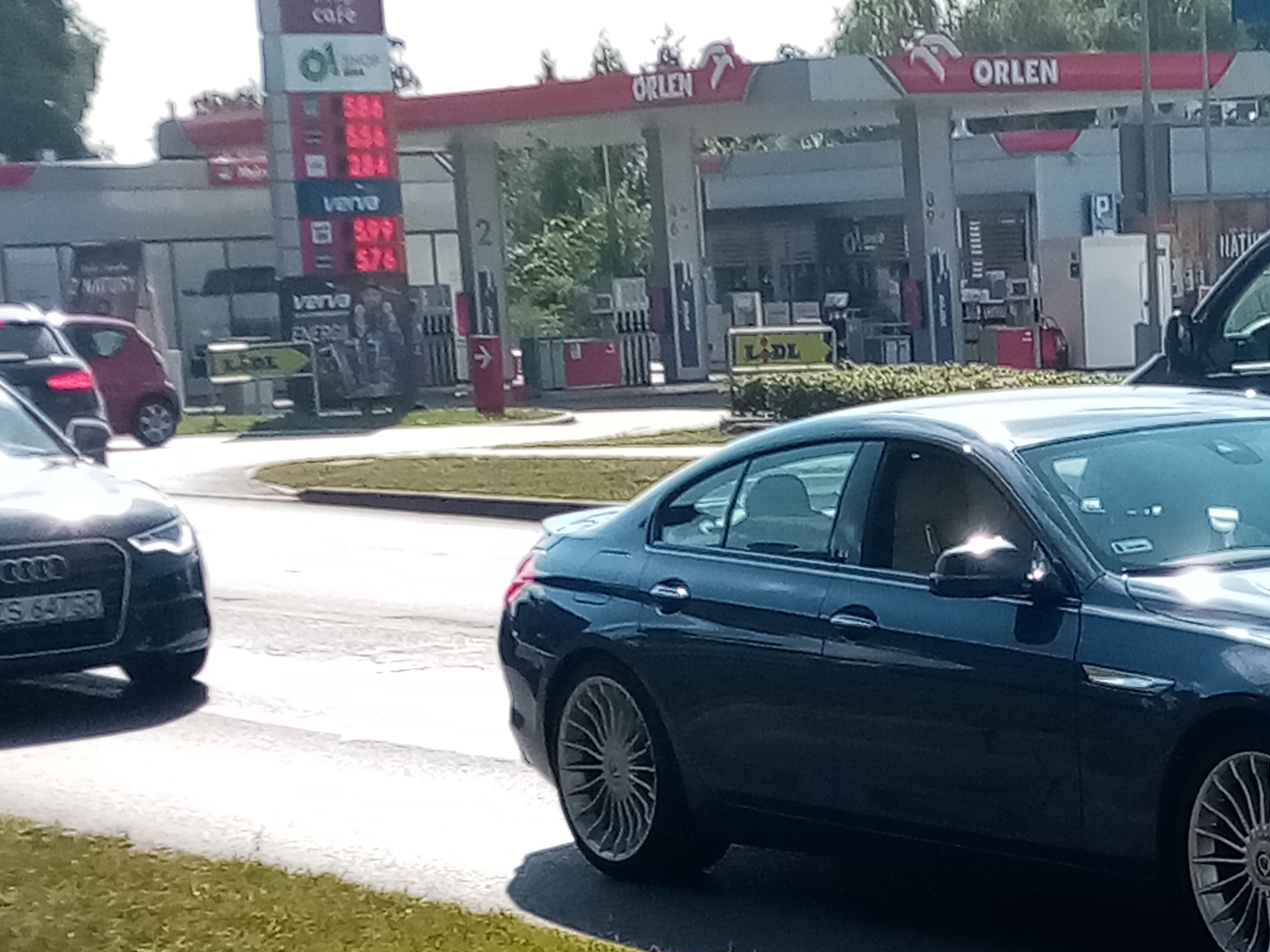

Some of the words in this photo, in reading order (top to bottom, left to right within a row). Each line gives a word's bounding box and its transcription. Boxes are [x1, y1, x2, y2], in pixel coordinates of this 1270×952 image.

[973, 58, 1059, 86] ORLEN
[632, 72, 693, 101] ORLEN
[323, 195, 380, 212] verva
[1096, 196, 1109, 217] P
[476, 218, 491, 246] 2
[293, 293, 351, 310] verva
[744, 336, 801, 362] LIDL
